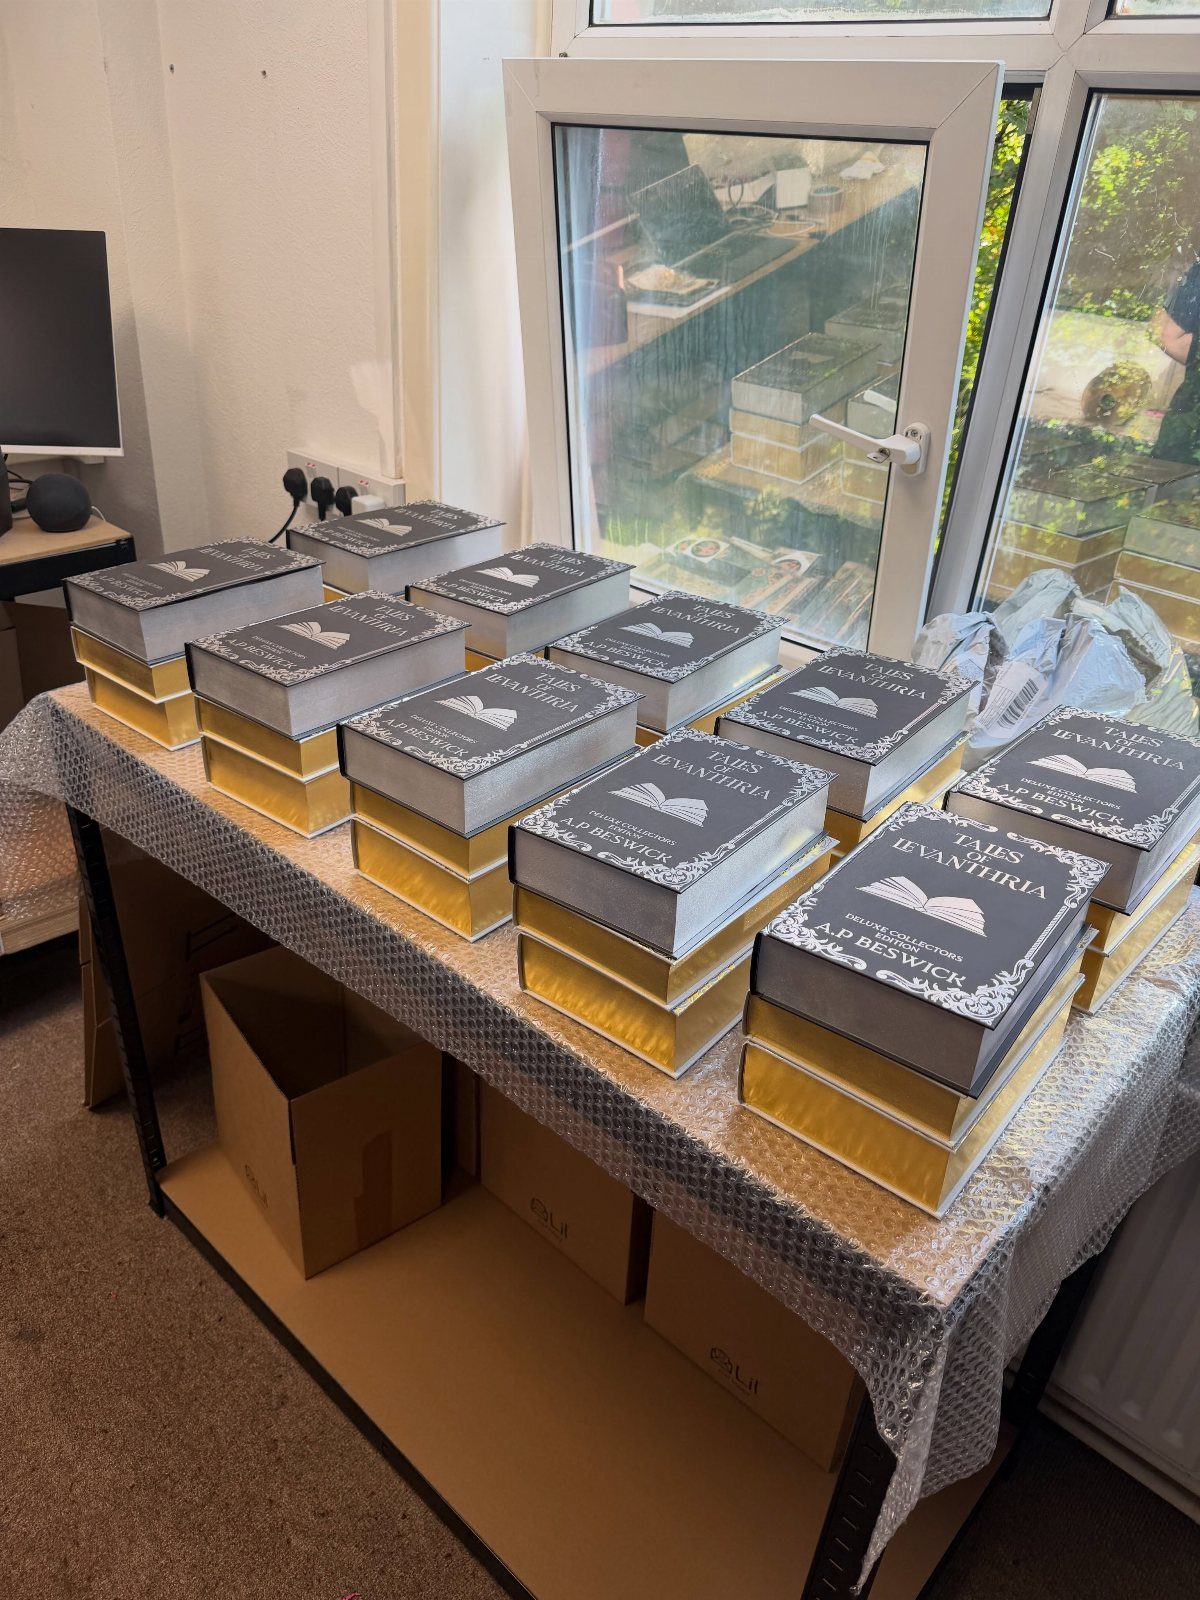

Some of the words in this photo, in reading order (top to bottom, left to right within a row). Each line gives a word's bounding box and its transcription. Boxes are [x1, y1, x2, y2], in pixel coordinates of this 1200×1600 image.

[375, 604, 415, 622] TALES
[651, 606, 741, 634] LEVANTHRIA
[693, 604, 735, 619] TALES
[246, 644, 298, 670] BESWICK
[605, 647, 669, 668] BESWICK
[536, 672, 581, 692] TALES
[818, 665, 926, 700] LEVANTHRIA
[863, 662, 914, 680] TALES
[484, 673, 579, 713] LEVANTHRIA
[538, 683, 552, 692] OF
[403, 726, 468, 757] BESWICK
[783, 717, 860, 744] BESWICK
[1104, 726, 1163, 748] TALES
[1115, 739, 1137, 748] OF
[706, 750, 764, 775] TALES
[1051, 729, 1185, 771] LEVANTHRIA
[652, 754, 772, 800] LEVANTHRIA
[713, 764, 734, 774] OF
[997, 783, 1029, 796] A.P
[1032, 792, 1124, 825] BESWICK
[1020, 777, 1060, 791] DELUXE
[1059, 787, 1121, 810] COLLECTORS
[1047, 790, 1085, 803] EDITION
[560, 817, 588, 830] A.P
[588, 826, 674, 863] BESWICK
[589, 810, 622, 827] DELUXE
[620, 823, 676, 846] COLLECTORS
[608, 824, 643, 840] EDITION
[954, 832, 1024, 864] TALES
[967, 851, 993, 864] OF
[892, 838, 1047, 899] LEVANTHRIA
[845, 912, 889, 934] DELUXE
[887, 928, 963, 963] COLLECTORS
[875, 932, 920, 954] EDITION
[815, 922, 853, 941] A.P
[854, 937, 967, 987] BESWICK
